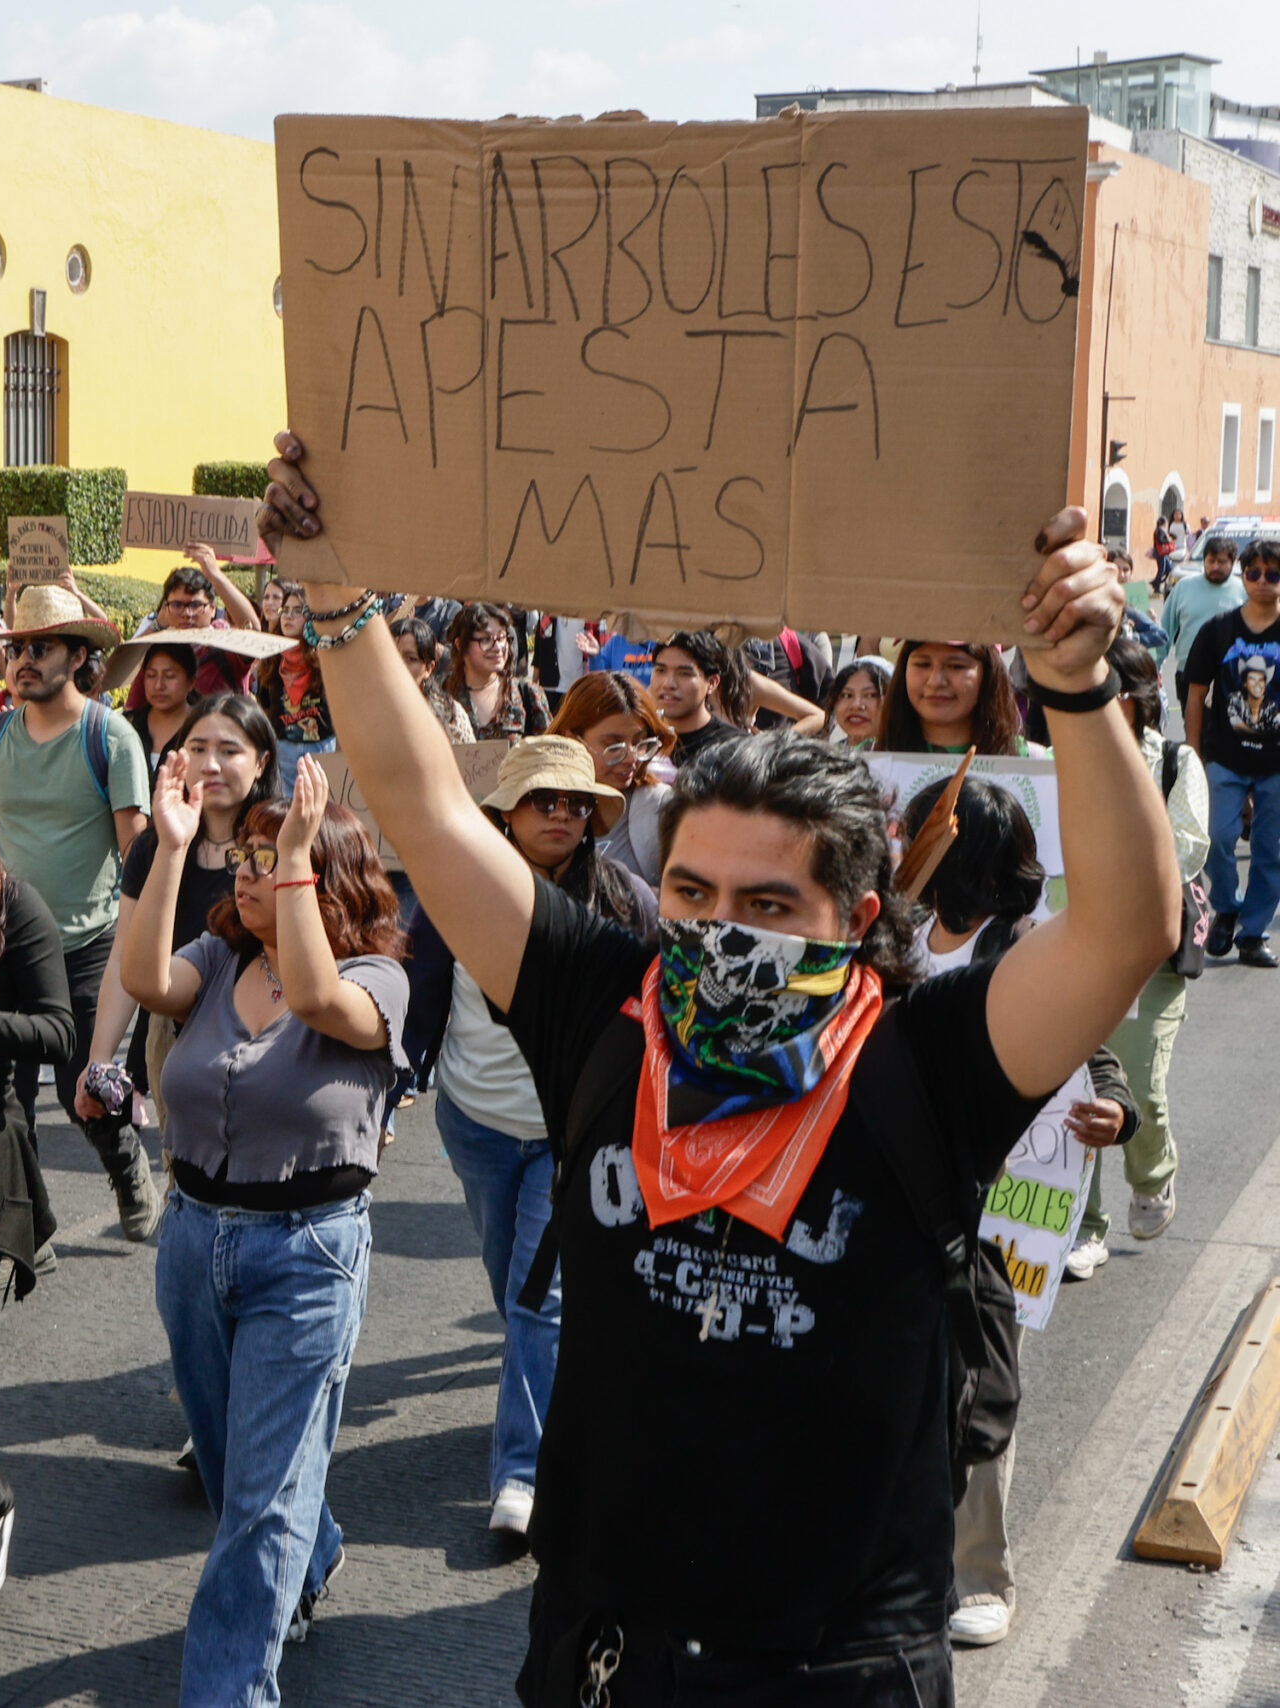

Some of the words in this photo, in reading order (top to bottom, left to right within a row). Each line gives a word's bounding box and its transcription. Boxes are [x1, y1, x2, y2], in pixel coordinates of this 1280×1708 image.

[300, 146, 459, 316] SIN
[340, 304, 881, 469] APESTA
[125, 496, 187, 545] ESTADO
[189, 510, 250, 543] ECOCIDA
[498, 465, 765, 588] MÁS
[983, 1173, 1074, 1233] BOLES
